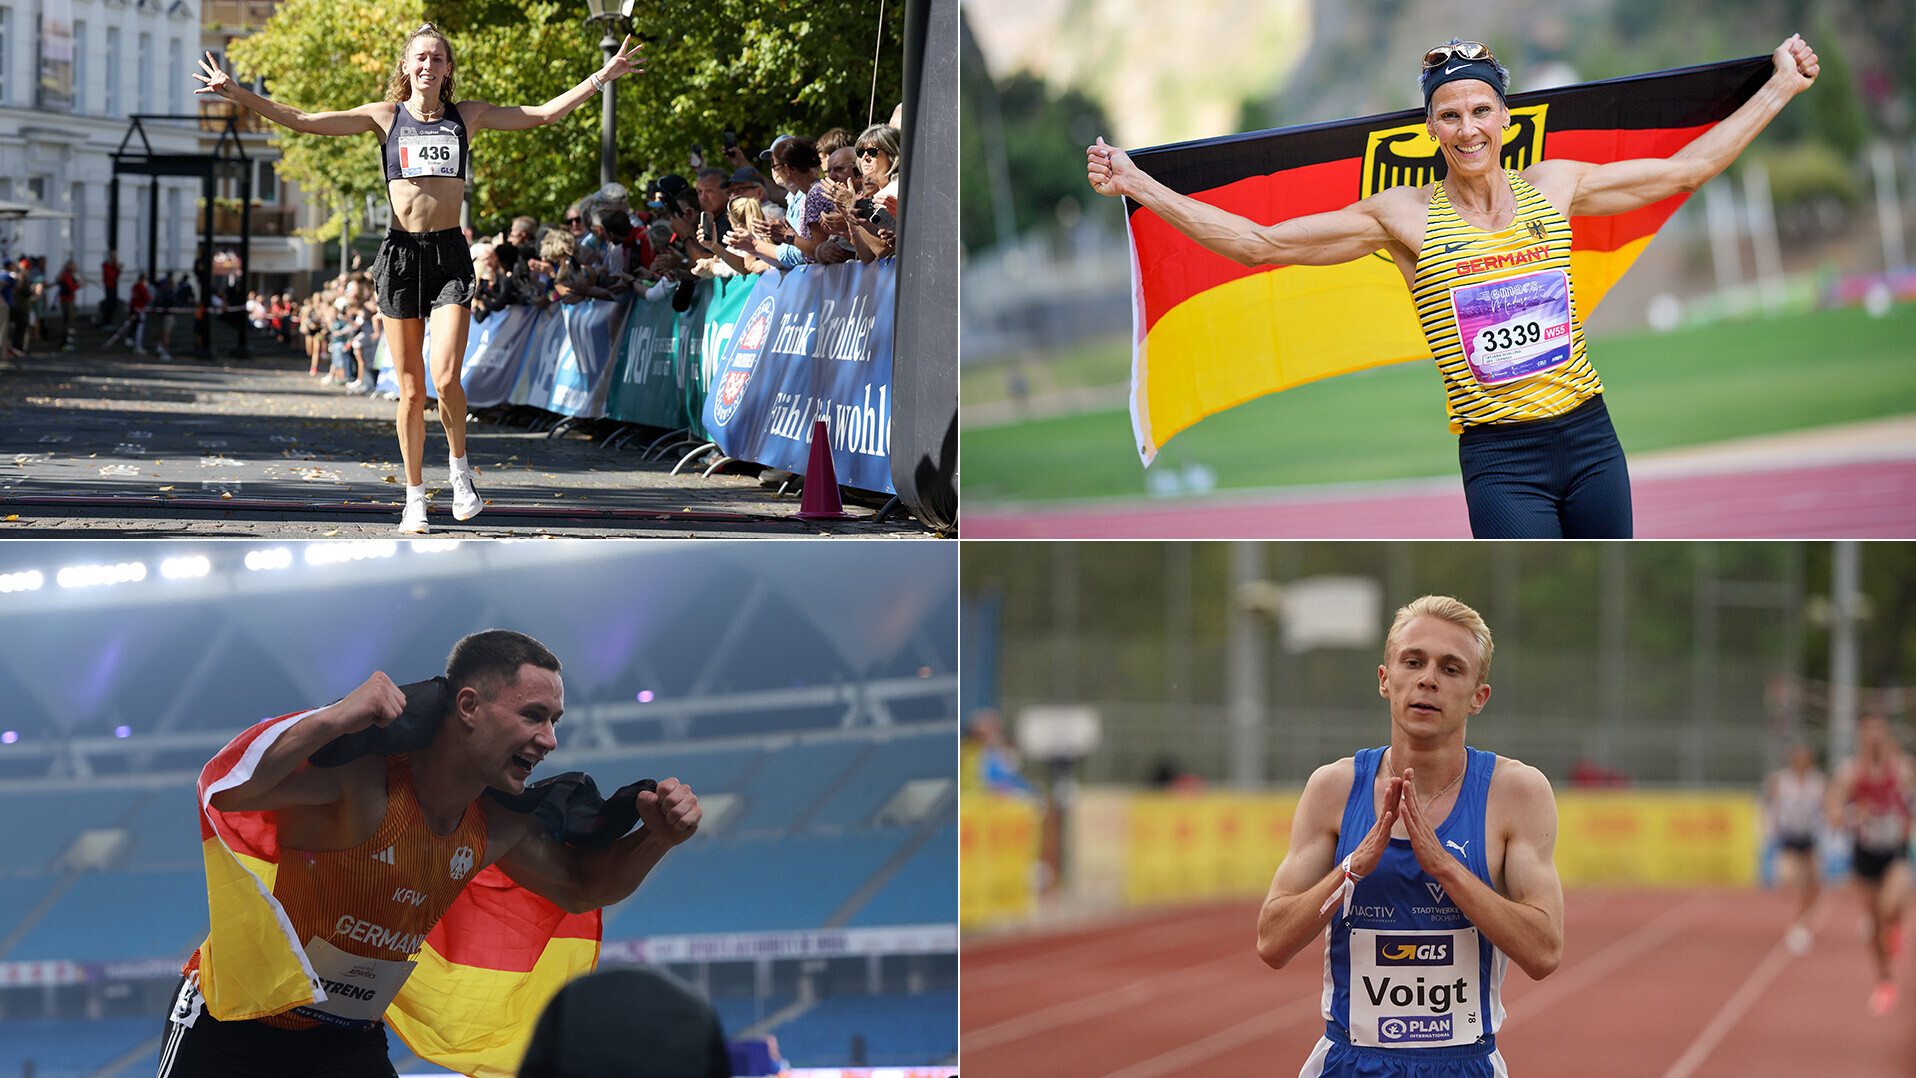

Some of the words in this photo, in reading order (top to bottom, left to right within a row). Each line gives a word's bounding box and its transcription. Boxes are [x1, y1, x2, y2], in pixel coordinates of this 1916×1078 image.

[419, 146, 450, 160] 436
[1456, 245, 1550, 276] GERMANY
[771, 312, 815, 356] Trink
[812, 294, 876, 363] Brohler.
[1482, 321, 1541, 352] 3339
[1545, 326, 1566, 339] W55
[1411, 906, 1460, 915] STADTWERKE
[1430, 913, 1461, 922] BOCHUM
[335, 914, 428, 954] GERMAN
[1416, 944, 1447, 960] GLS
[1362, 976, 1468, 1014] Voigt
[1409, 1019, 1450, 1032] PLAN
[1467, 1011, 1477, 1024] 78
